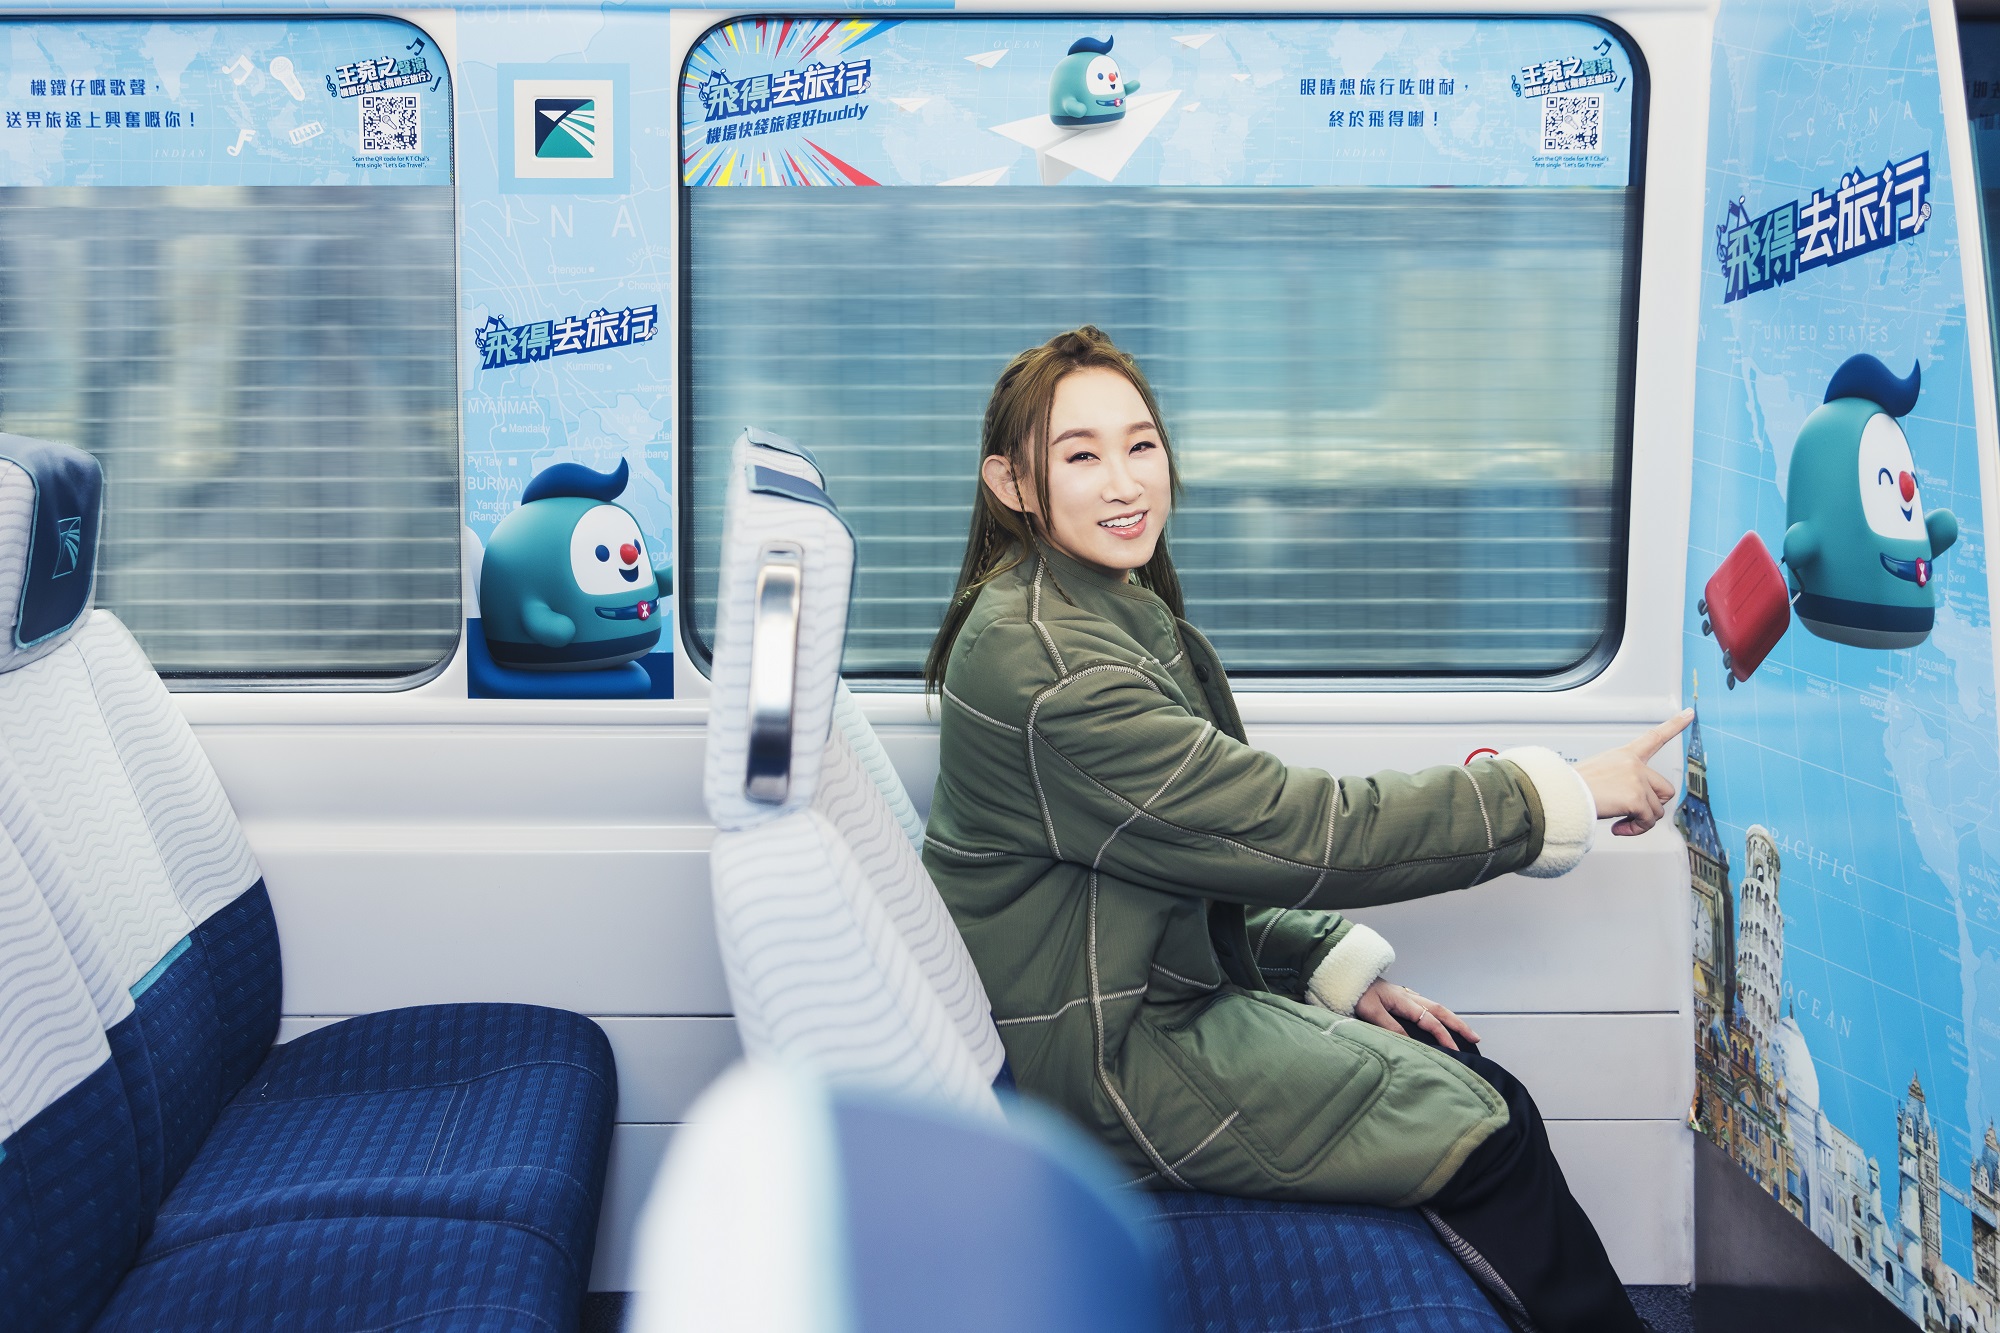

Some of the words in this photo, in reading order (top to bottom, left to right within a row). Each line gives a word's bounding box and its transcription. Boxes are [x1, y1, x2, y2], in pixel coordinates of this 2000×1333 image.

[703, 60, 871, 122] 飛得去旅行
[1720, 150, 1931, 304] 飛得去旅行
[478, 304, 658, 370] 飛得去旅行
[1764, 325, 1817, 341] UNITED
[1828, 325, 1889, 343] STATES
[566, 361, 605, 373] Kunming
[467, 400, 540, 415] MYANMAR
[509, 423, 551, 435] Mandalay
[573, 437, 613, 450] LAOS
[475, 500, 511, 513] Yangon
[1771, 827, 1855, 885] PACIFIC
[1783, 980, 1852, 1038] OCEAN
